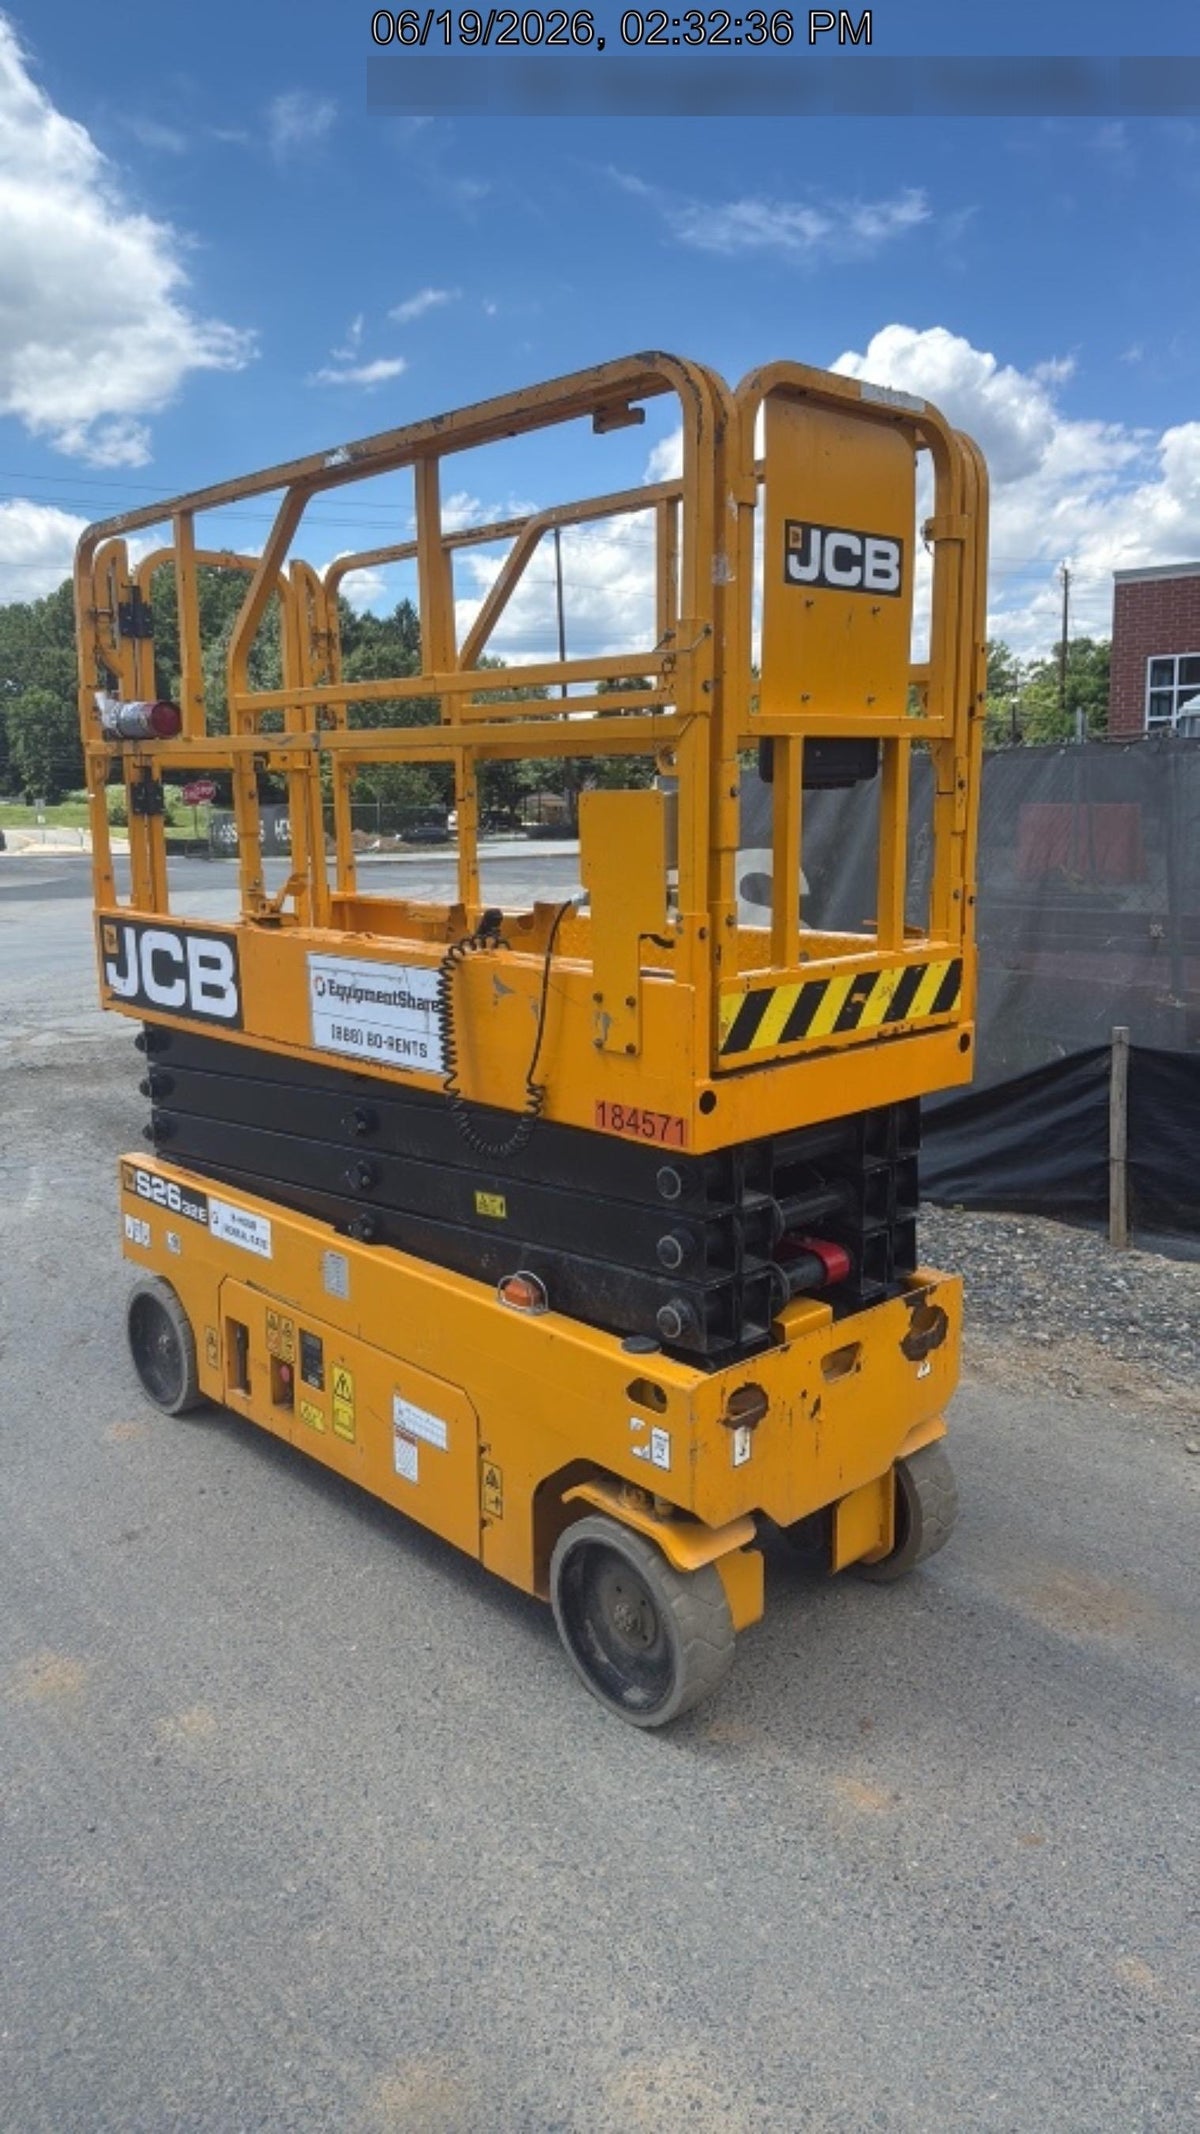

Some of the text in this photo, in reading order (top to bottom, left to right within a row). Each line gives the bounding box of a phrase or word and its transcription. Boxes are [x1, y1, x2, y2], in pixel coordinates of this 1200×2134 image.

[787, 528, 900, 592] JCB
[105, 926, 238, 1018] JCB
[328, 979, 441, 1014] EquipmentShare
[596, 1101, 685, 1146] 184571
